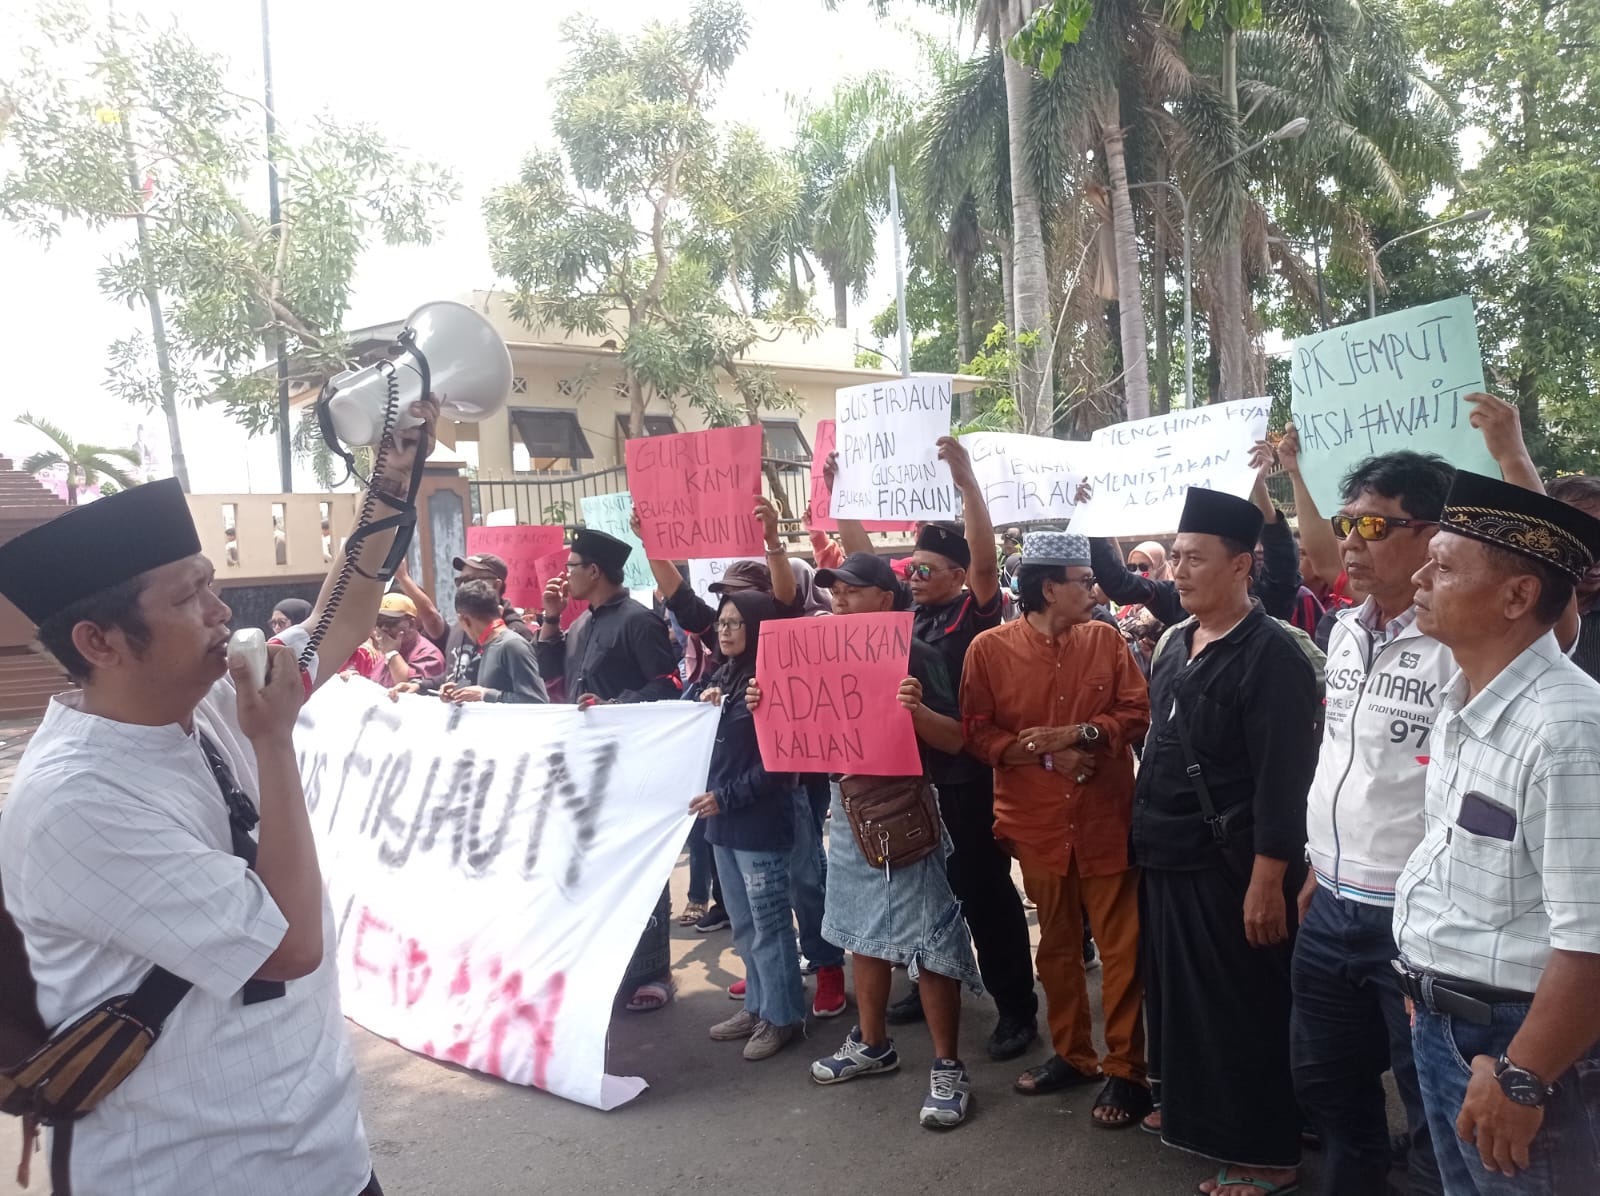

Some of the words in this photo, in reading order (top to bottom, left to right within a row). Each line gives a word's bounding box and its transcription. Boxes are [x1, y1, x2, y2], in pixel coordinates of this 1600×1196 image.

[1338, 314, 1453, 386] JEMPUT
[872, 381, 951, 416] FIRJAUN
[635, 433, 710, 472] GURU
[844, 431, 897, 469] PAMAN
[684, 463, 741, 494] KAMI
[1091, 449, 1231, 497] MENISTAKAN
[638, 495, 697, 520] BUKAN
[837, 488, 872, 513] BUKAN
[876, 484, 952, 518] FIRAUN
[759, 620, 910, 670] TUNJUKKAN
[766, 673, 864, 723] ADAB
[1367, 672, 1438, 708] MARK
[1367, 703, 1434, 725] INDIVIDUAL
[774, 727, 865, 762] KALIAN
[1389, 719, 1431, 749] 97
